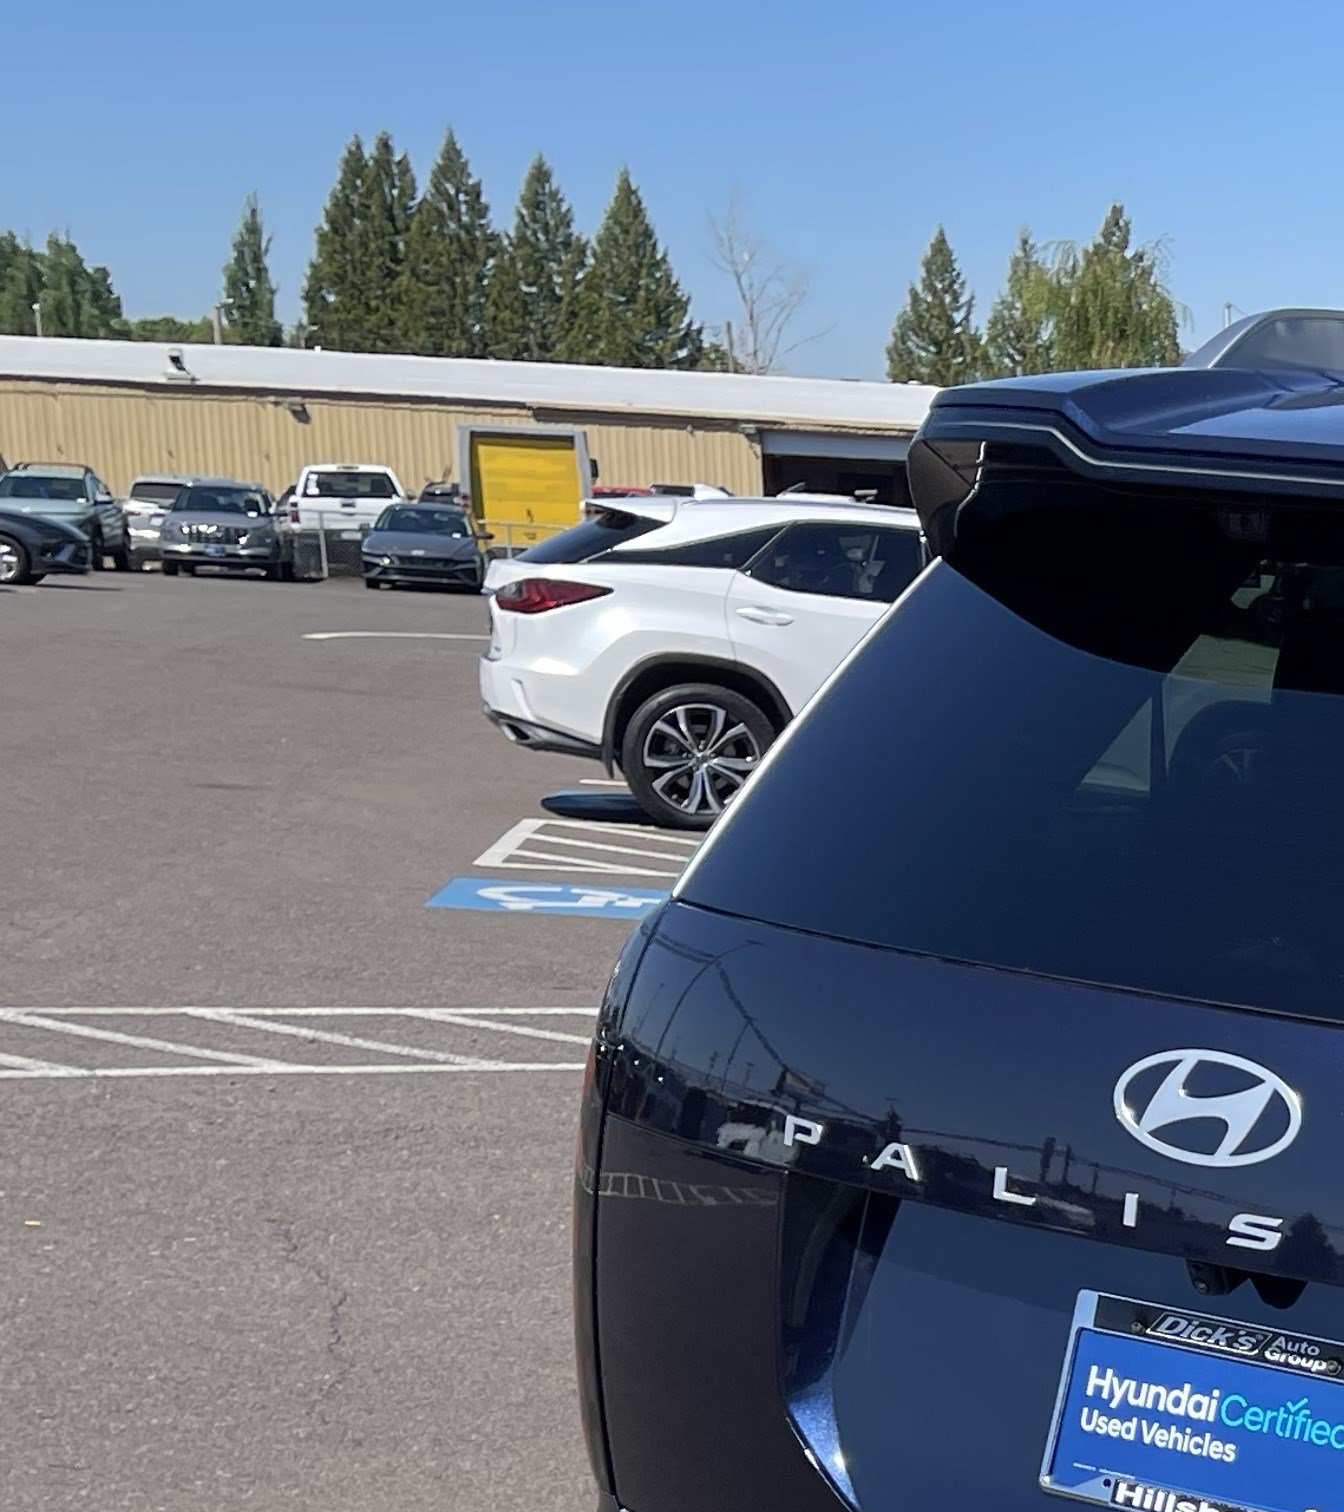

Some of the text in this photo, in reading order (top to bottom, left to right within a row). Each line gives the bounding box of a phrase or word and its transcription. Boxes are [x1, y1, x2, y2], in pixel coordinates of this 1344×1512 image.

[1156, 1316, 1321, 1356] Dick's Auto
[1263, 1347, 1328, 1372] Group
[1085, 1365, 1221, 1422] Hyundai
[1080, 1407, 1237, 1463] Used Vehicles
